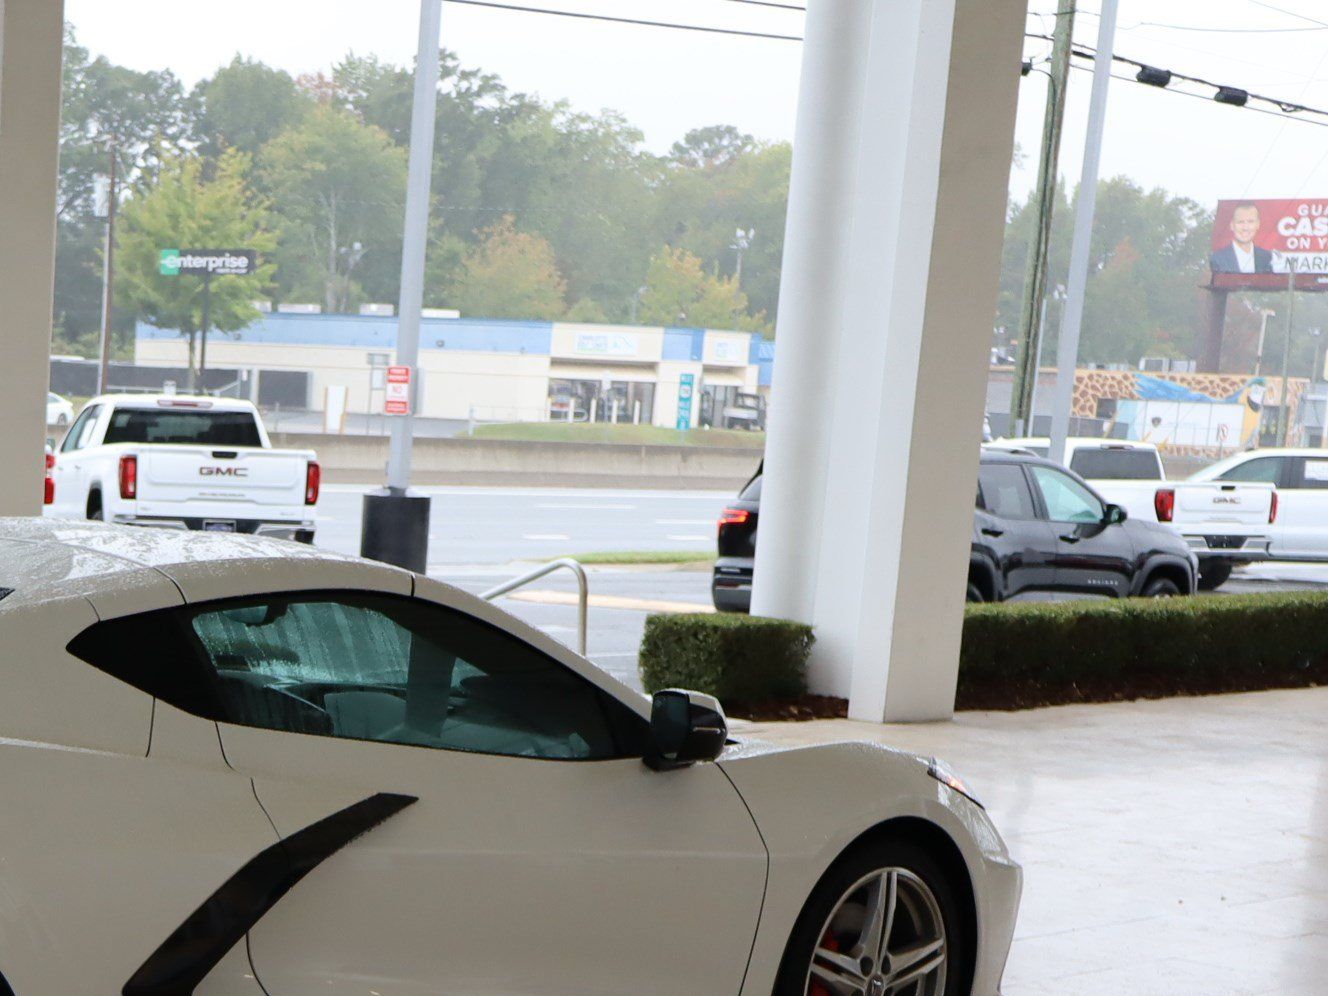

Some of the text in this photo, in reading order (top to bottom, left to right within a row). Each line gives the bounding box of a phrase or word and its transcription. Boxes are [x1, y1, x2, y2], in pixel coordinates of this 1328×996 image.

[1277, 216, 1328, 237] CAS
[1287, 237, 1311, 250] ON
[161, 252, 249, 272] enterprise
[199, 466, 248, 477] GMC
